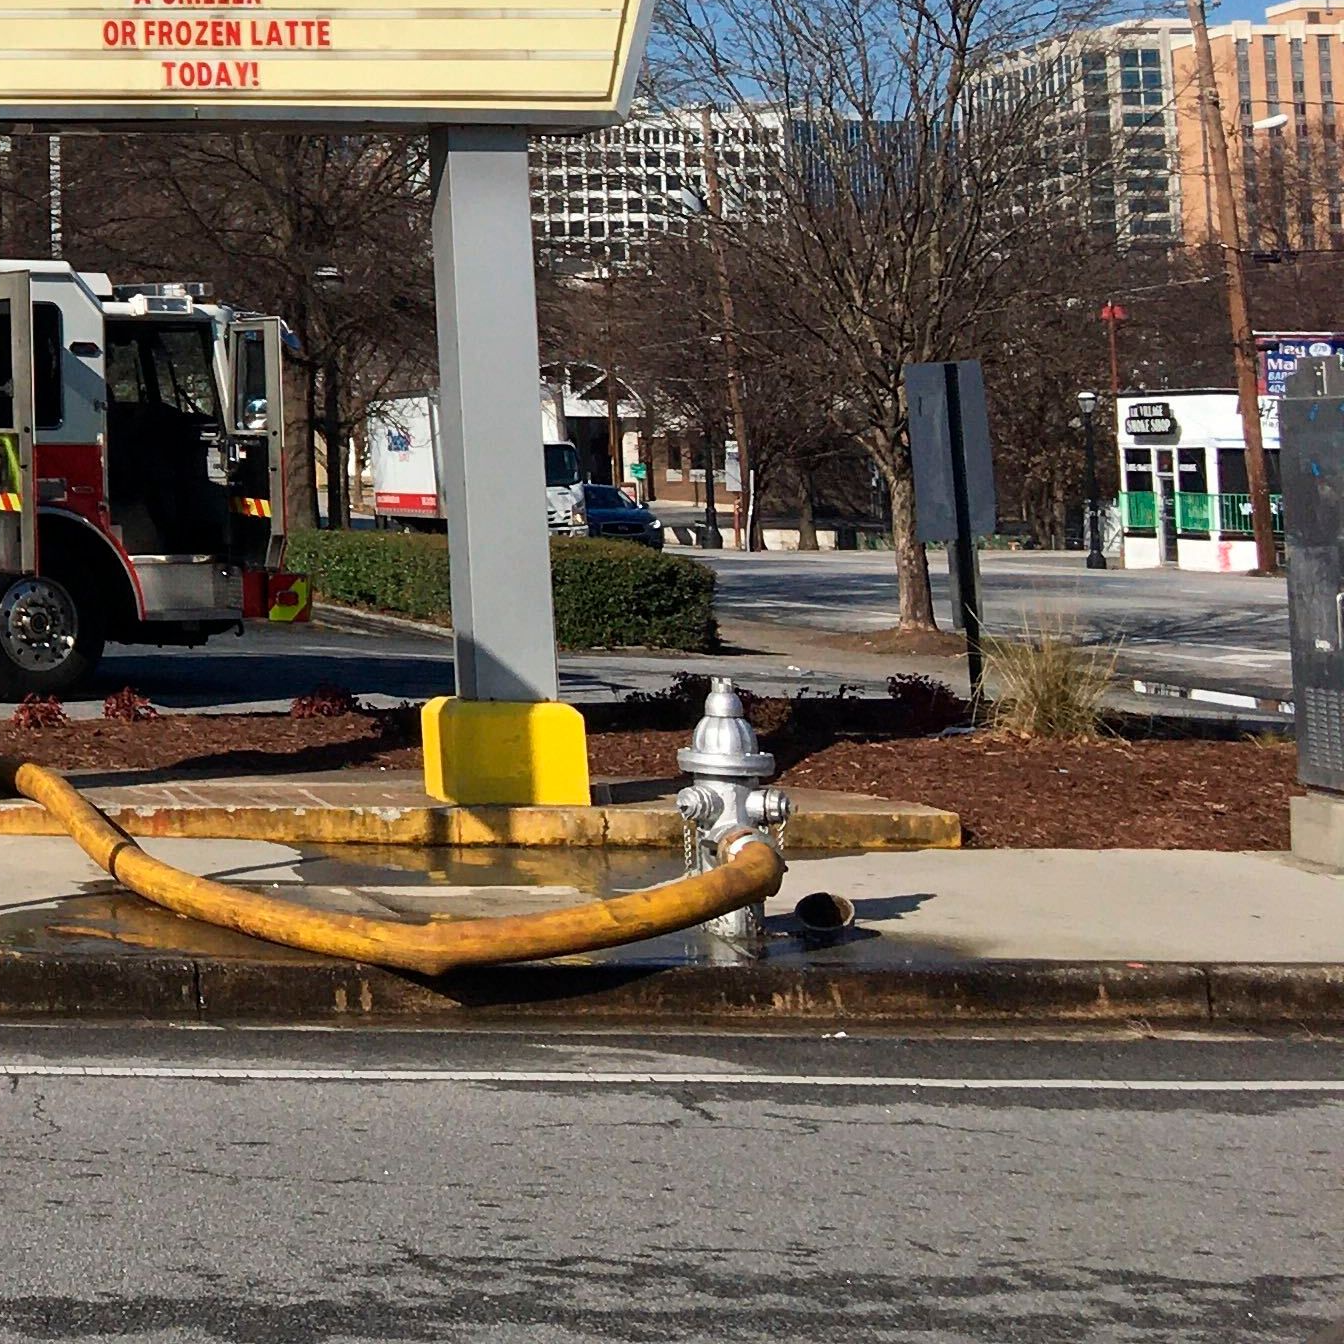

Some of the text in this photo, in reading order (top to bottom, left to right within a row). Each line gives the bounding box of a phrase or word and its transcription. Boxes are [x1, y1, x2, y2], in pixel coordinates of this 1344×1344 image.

[103, 21, 331, 46] OR FROZEN LATTE
[162, 61, 259, 87] TODAY!
